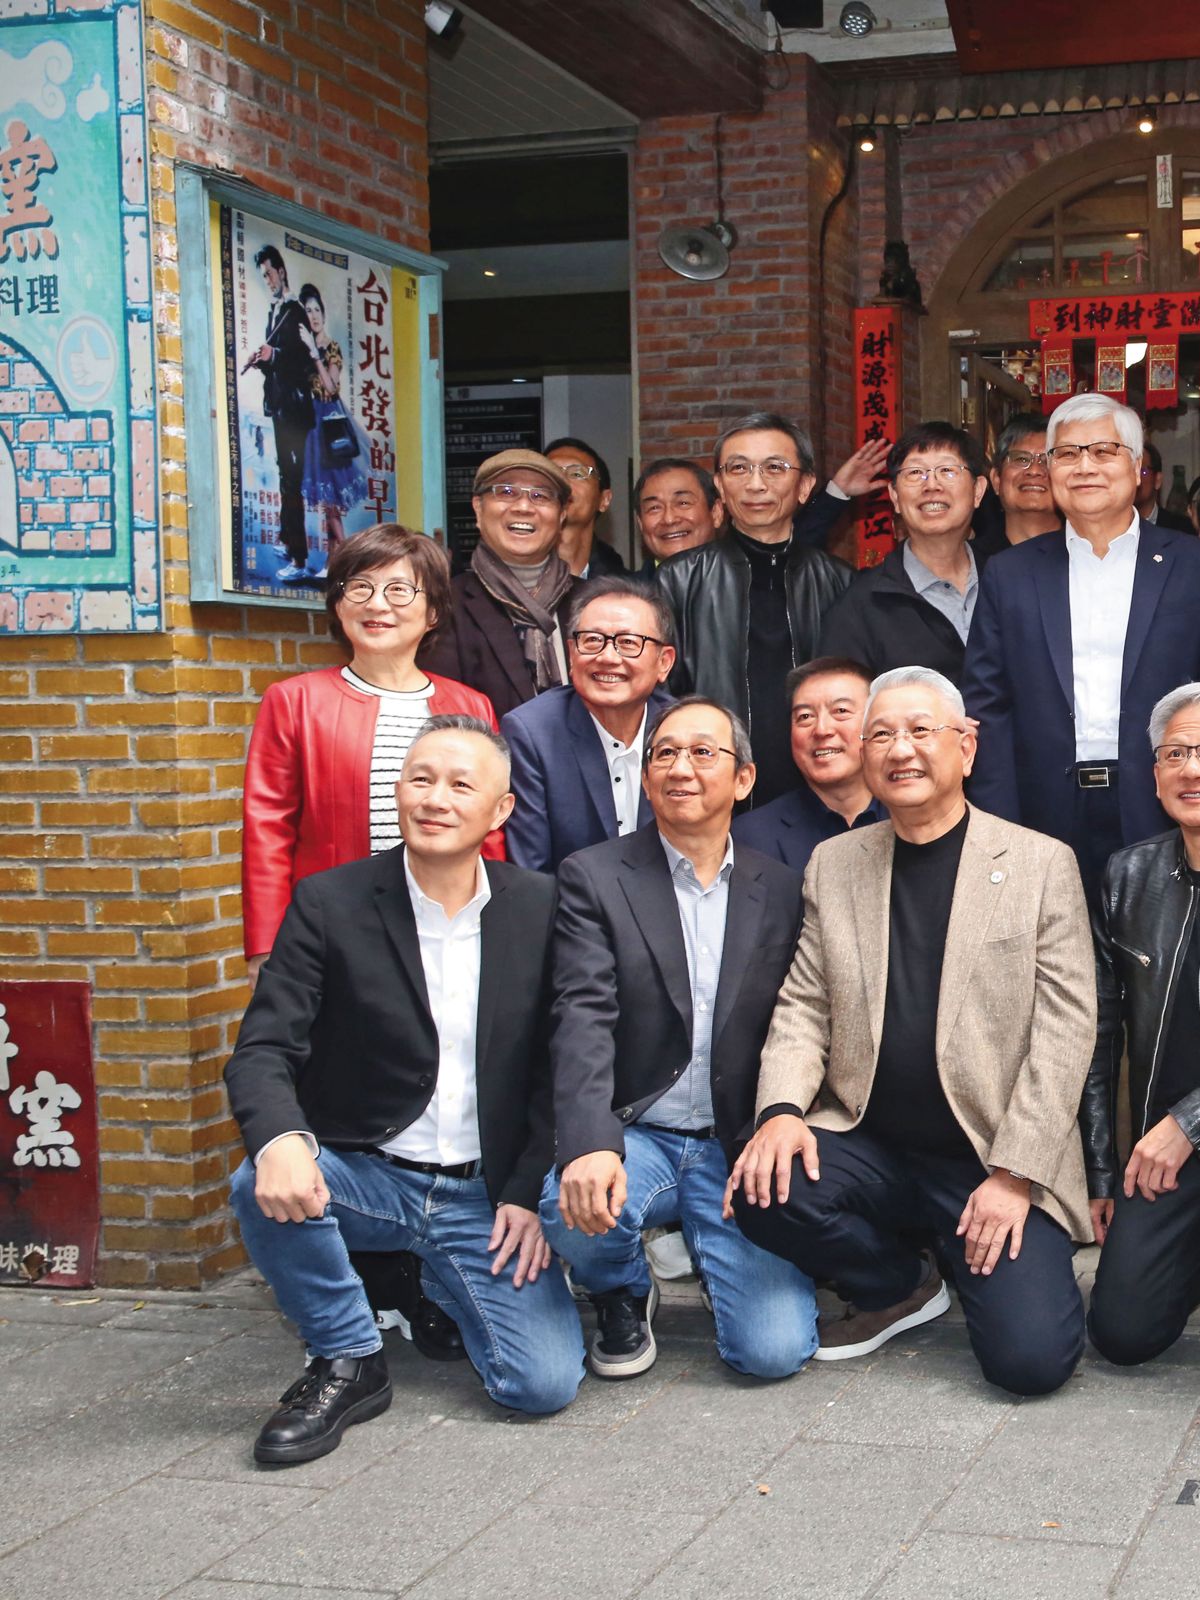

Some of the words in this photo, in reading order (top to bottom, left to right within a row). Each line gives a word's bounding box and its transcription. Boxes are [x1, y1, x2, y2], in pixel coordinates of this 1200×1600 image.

[356, 268, 396, 524] 台北發的早
[860, 332, 892, 540] 財源茂盛三江
